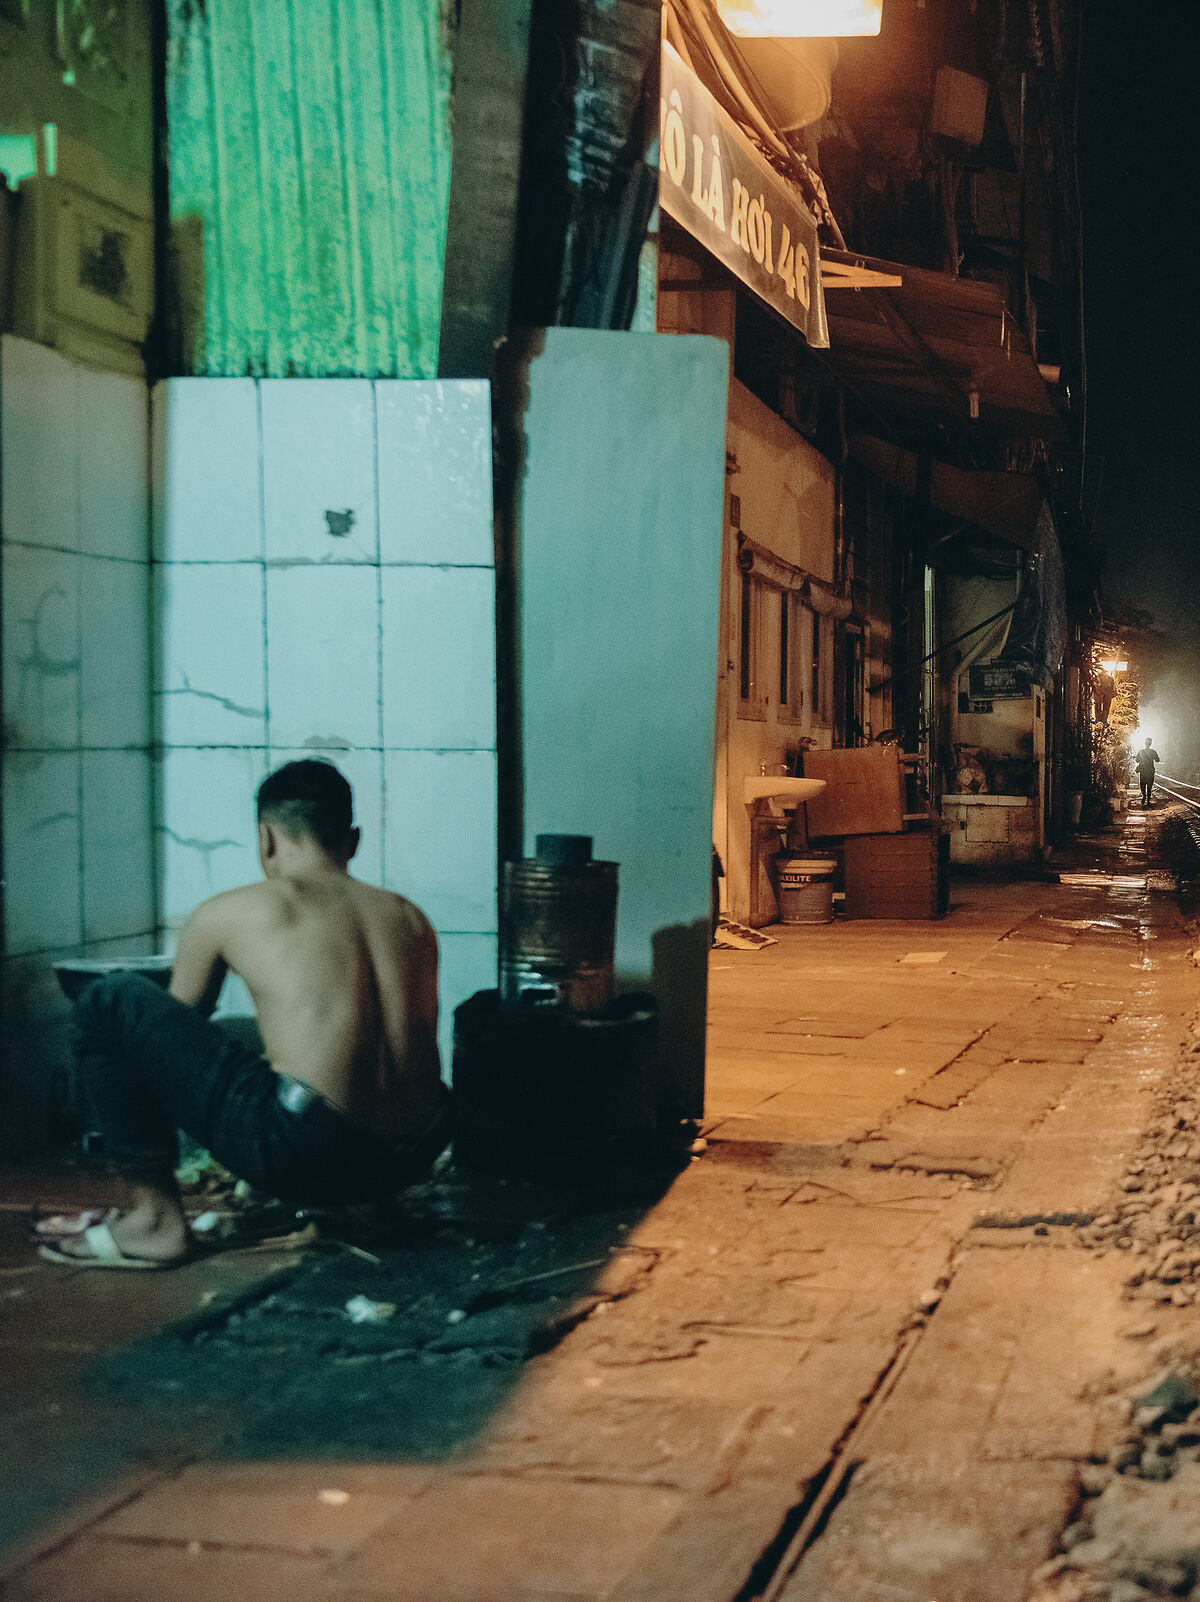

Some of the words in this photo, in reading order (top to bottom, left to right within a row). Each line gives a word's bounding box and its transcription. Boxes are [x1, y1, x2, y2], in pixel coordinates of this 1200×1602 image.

[661, 88, 686, 186] Ô
[691, 134, 725, 231] LÀ
[778, 223, 811, 311] 46
